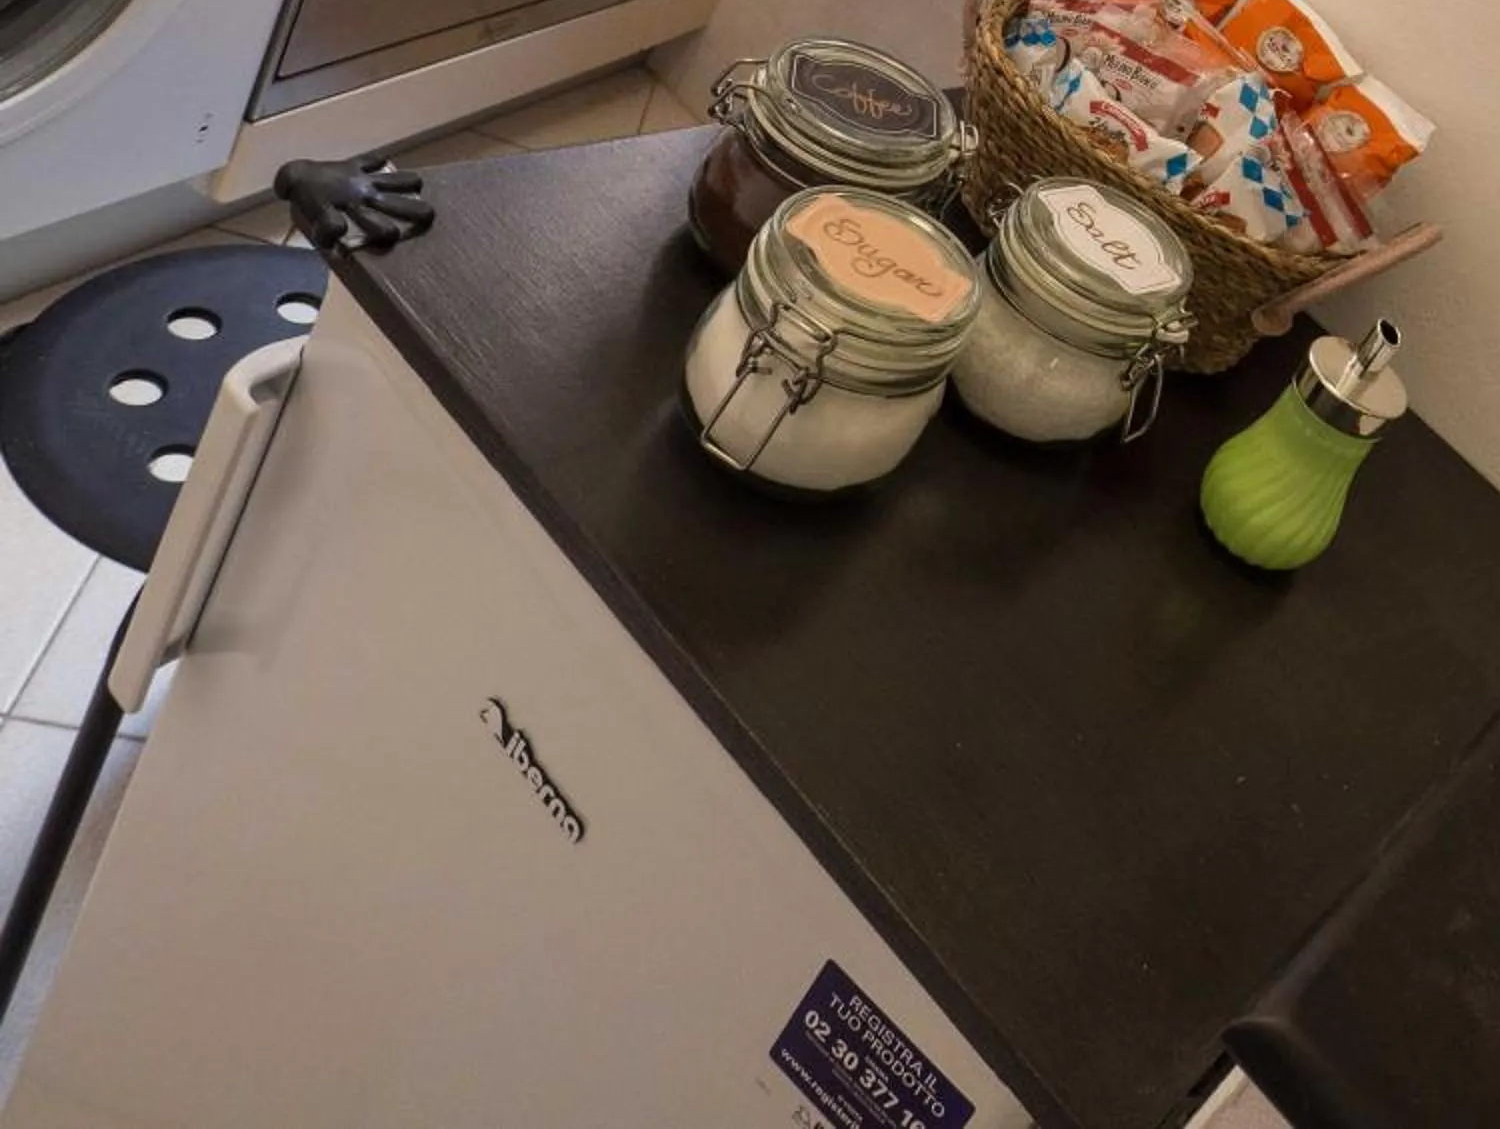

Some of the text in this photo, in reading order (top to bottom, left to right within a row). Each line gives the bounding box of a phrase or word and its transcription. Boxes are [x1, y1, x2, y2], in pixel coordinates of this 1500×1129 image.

[823, 218, 943, 297] Sugar
[1067, 202, 1142, 270] Salt
[805, 1010, 831, 1043] 02
[831, 1039, 859, 1070] 30
[859, 1068, 900, 1108] 377
[830, 991, 861, 1031] TUO
[861, 1030, 945, 1118] PRODOTTO
[850, 994, 923, 1076] REGISTRA
[924, 1072, 937, 1094] IL
